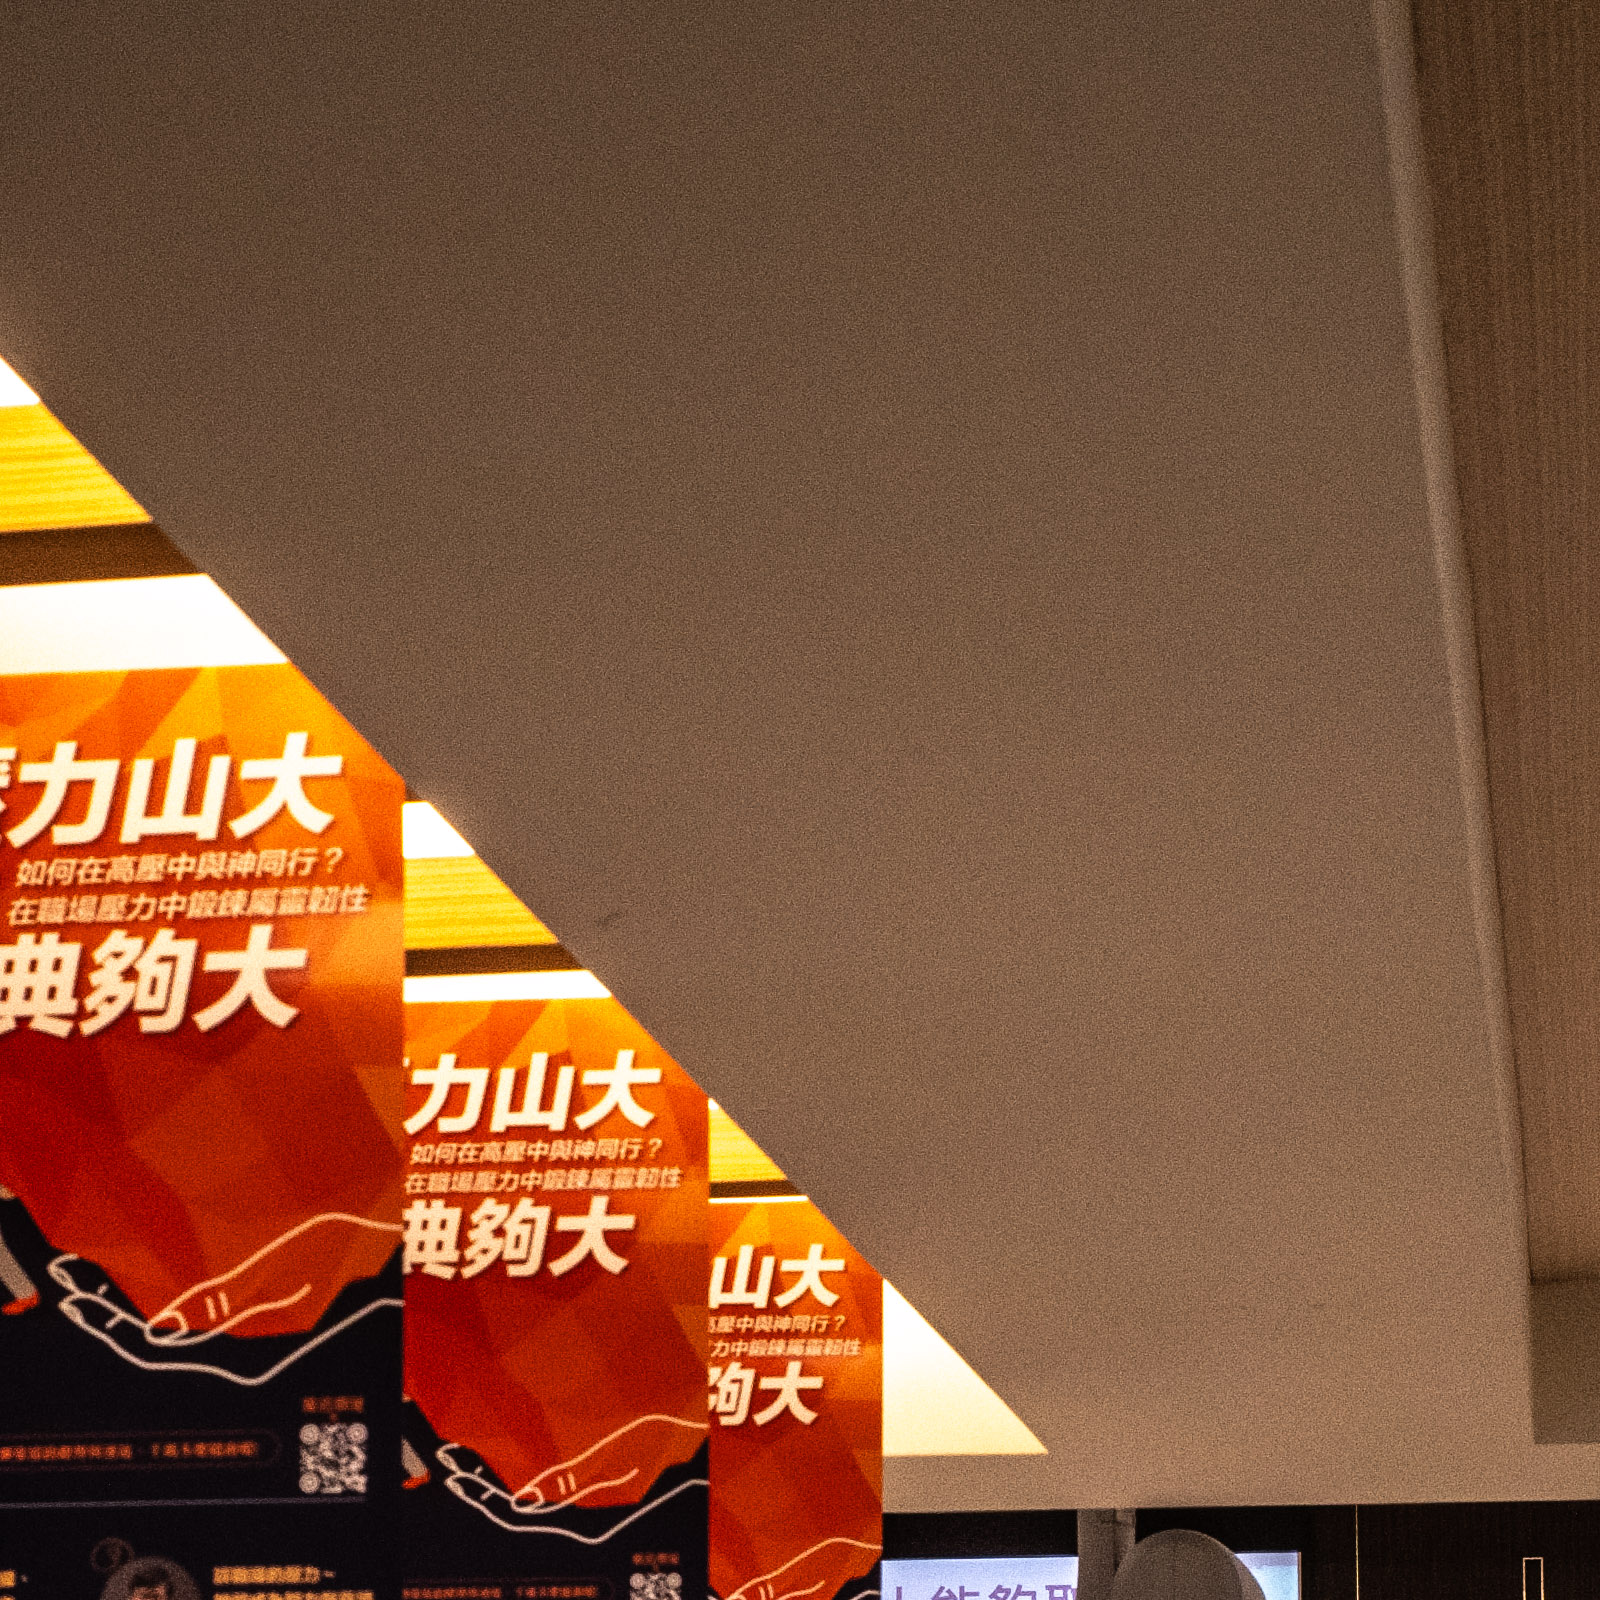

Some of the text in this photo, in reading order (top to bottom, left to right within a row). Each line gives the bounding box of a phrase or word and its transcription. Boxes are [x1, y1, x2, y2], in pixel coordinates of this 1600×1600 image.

[14, 847, 344, 889] 如何在高壓中與神同行？
[708, 1242, 846, 1310] 山大
